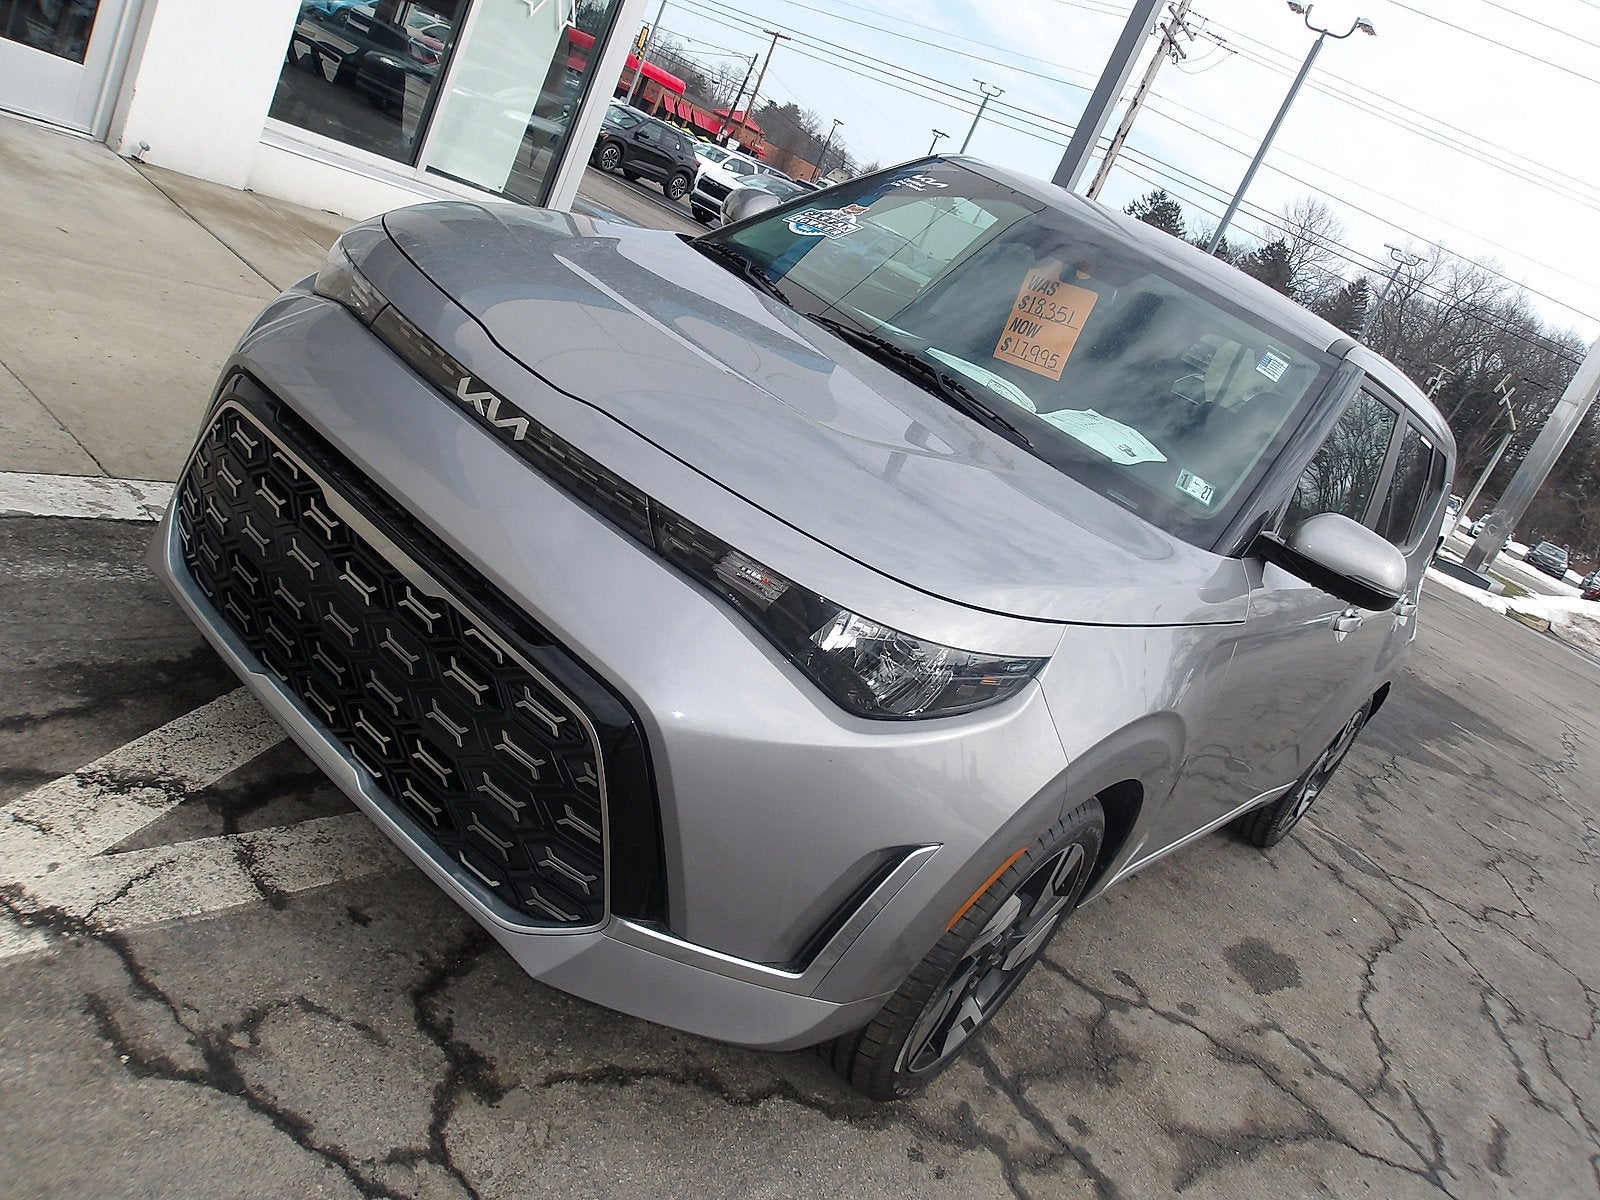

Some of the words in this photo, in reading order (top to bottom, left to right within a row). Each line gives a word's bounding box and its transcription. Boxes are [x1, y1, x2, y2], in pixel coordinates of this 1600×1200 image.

[1027, 275, 1060, 296] WAS
[1018, 295, 1075, 325] $18,351
[1008, 316, 1042, 338] NOW
[1000, 336, 1060, 369] $17,995
[457, 376, 529, 441] KIA
[1200, 485, 1213, 501] 27
